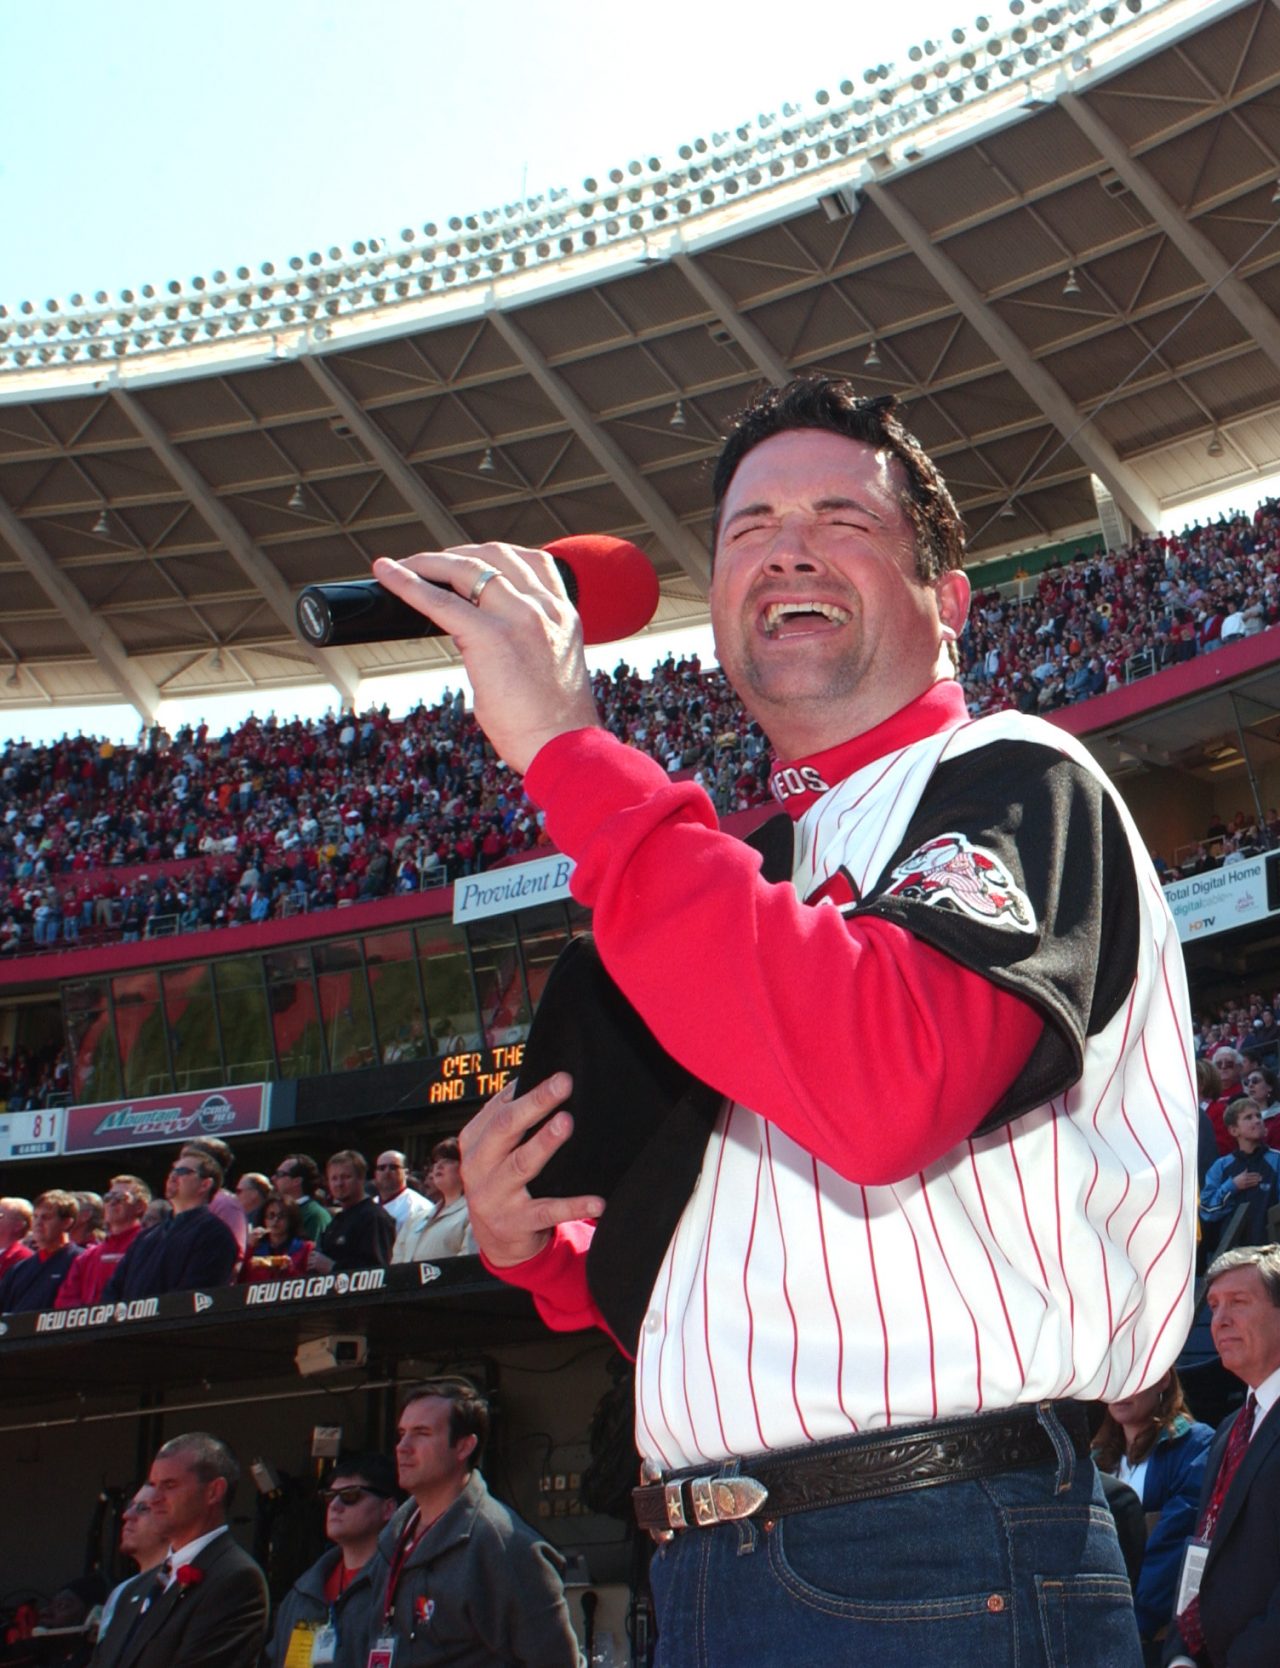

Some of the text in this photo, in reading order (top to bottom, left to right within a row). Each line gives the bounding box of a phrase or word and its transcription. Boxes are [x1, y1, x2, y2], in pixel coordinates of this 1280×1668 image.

[771, 765, 830, 804] EDS
[460, 873, 550, 911] Provident
[1164, 865, 1261, 902] Total Digital Home
[492, 1043, 526, 1069] THE
[429, 1079, 465, 1104] AND
